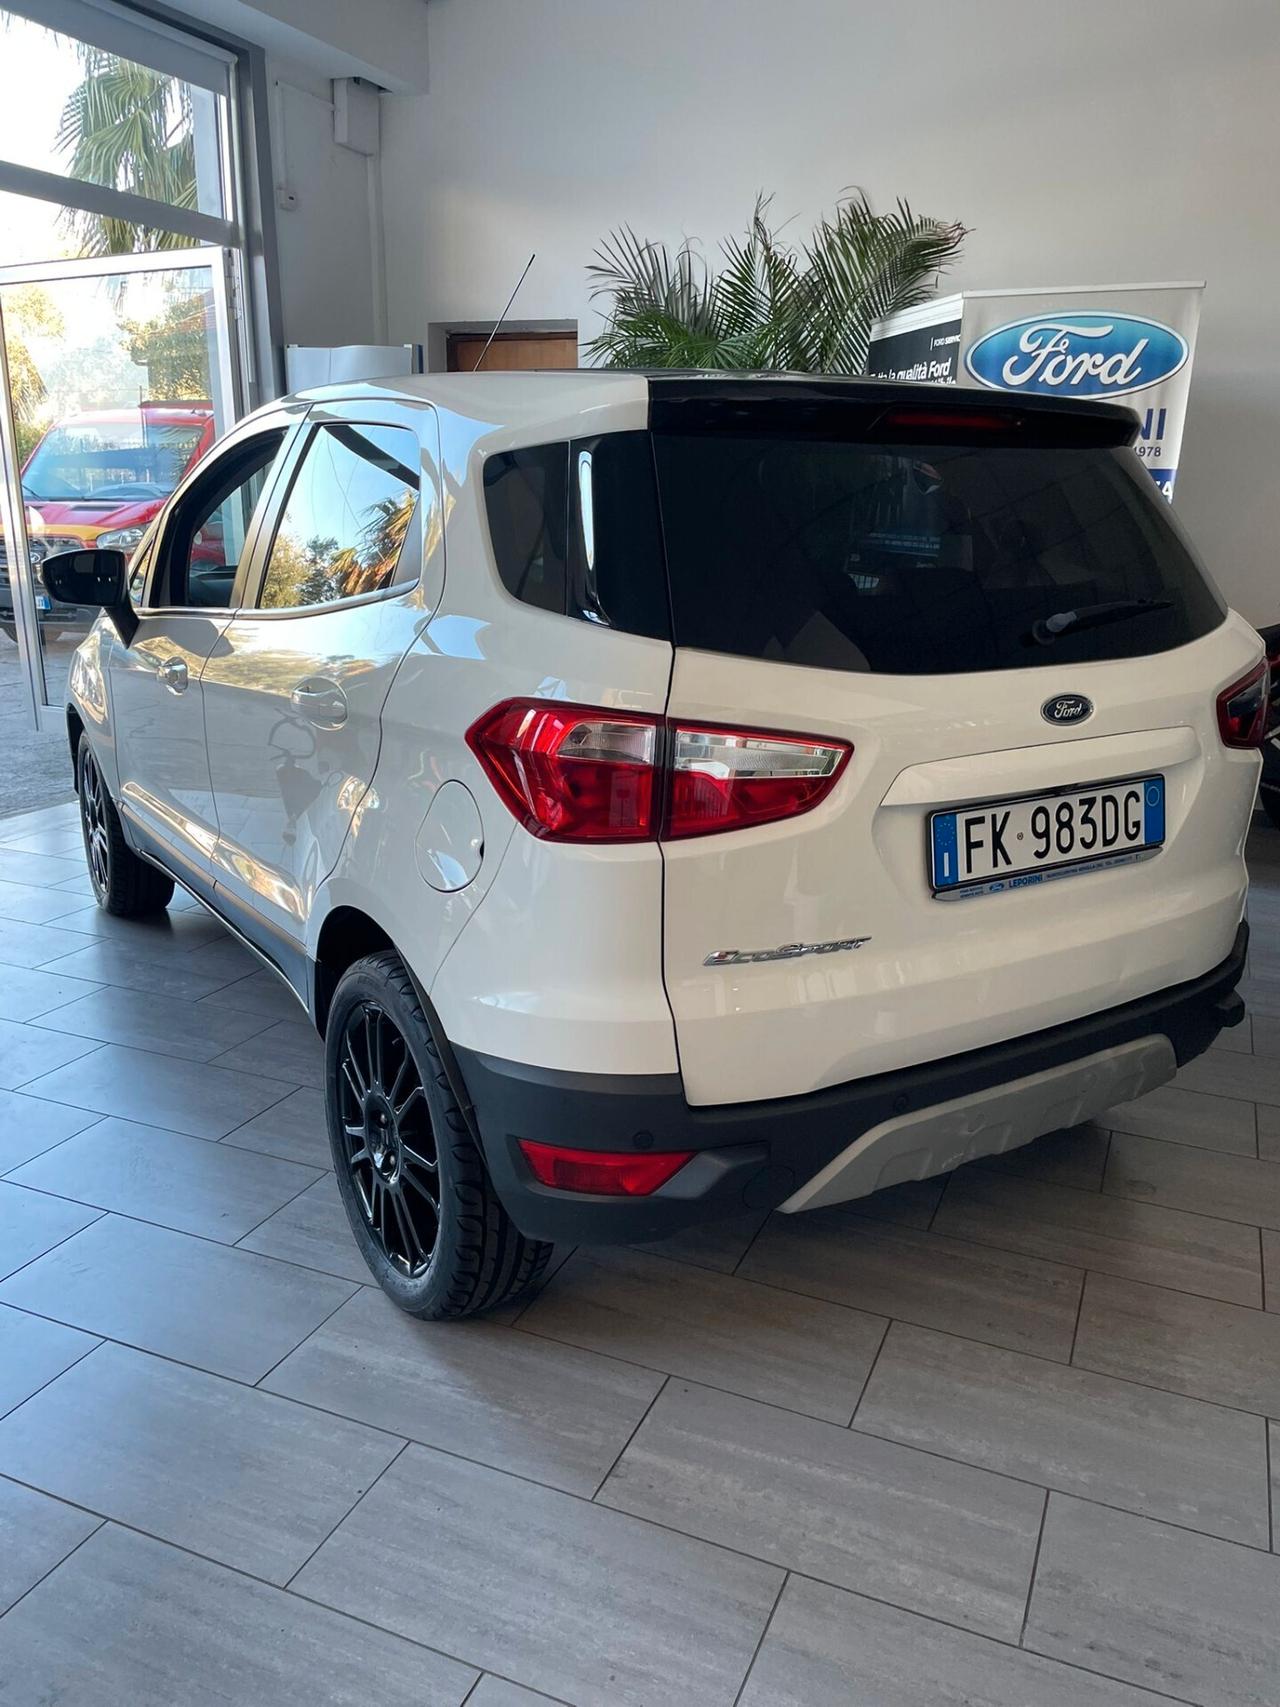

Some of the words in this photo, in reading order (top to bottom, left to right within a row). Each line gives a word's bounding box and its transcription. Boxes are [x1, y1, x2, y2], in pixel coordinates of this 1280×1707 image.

[945, 334, 961, 345] SERVIC
[1002, 323, 1149, 386] Ford
[928, 357, 952, 378] Ford
[1139, 408, 1167, 440] NI
[1054, 700, 1083, 719] Ford
[964, 811, 1012, 874] FK
[1030, 790, 1142, 859] 983DG
[1008, 873, 1044, 888] LEPORINI
